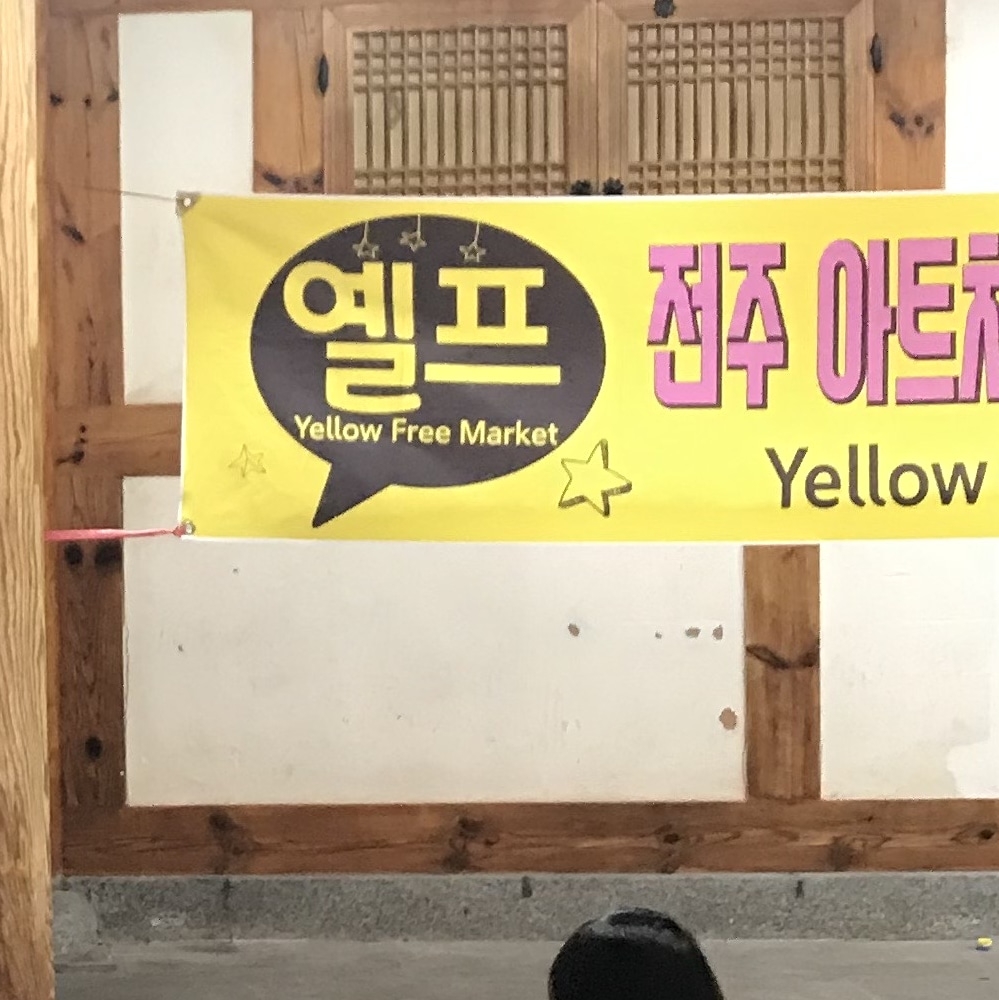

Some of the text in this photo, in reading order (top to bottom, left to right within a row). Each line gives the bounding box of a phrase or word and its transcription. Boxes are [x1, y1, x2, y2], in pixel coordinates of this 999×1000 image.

[283, 260, 562, 413] 옐프
[647, 242, 788, 409] 전주
[294, 414, 559, 447] Yellow Free Market
[764, 443, 988, 508] Yellow
